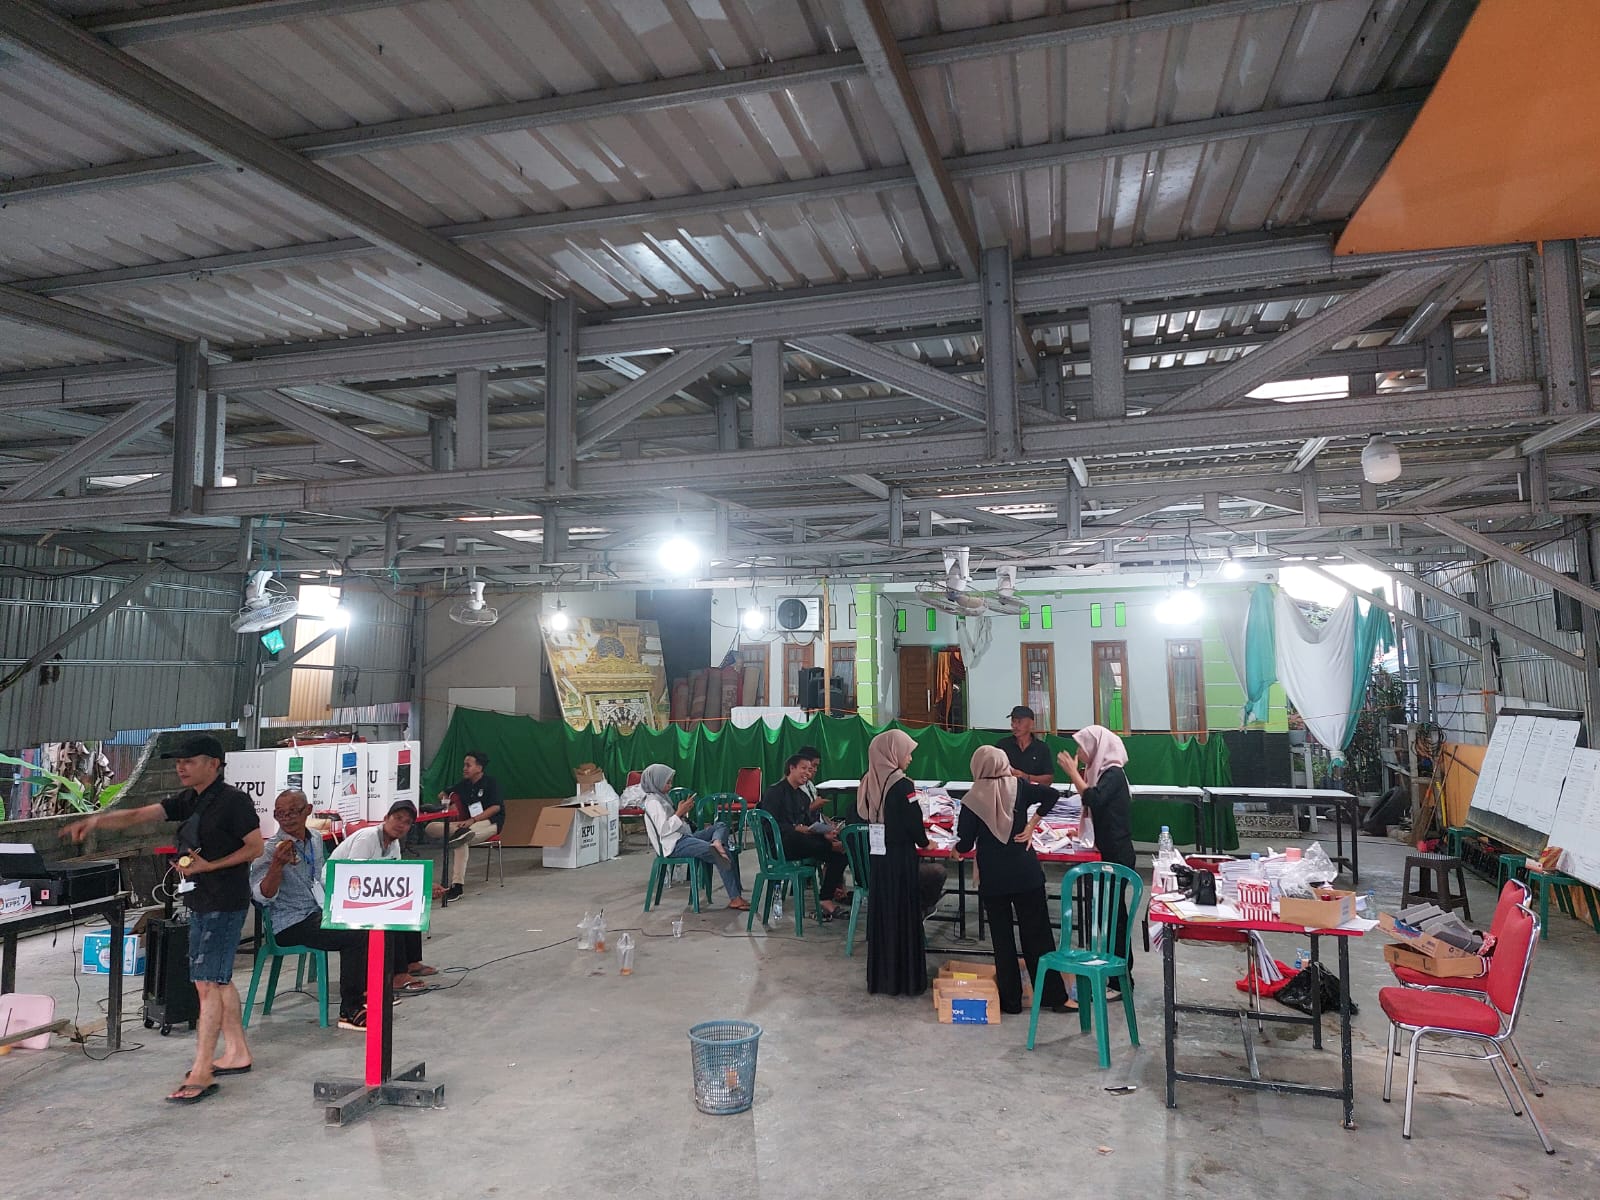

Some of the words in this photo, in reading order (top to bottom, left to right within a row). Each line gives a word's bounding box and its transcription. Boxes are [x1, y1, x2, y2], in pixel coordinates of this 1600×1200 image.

[581, 825, 595, 838] KPU
[362, 876, 410, 898] SAKSI
[20, 895, 26, 904] 7
